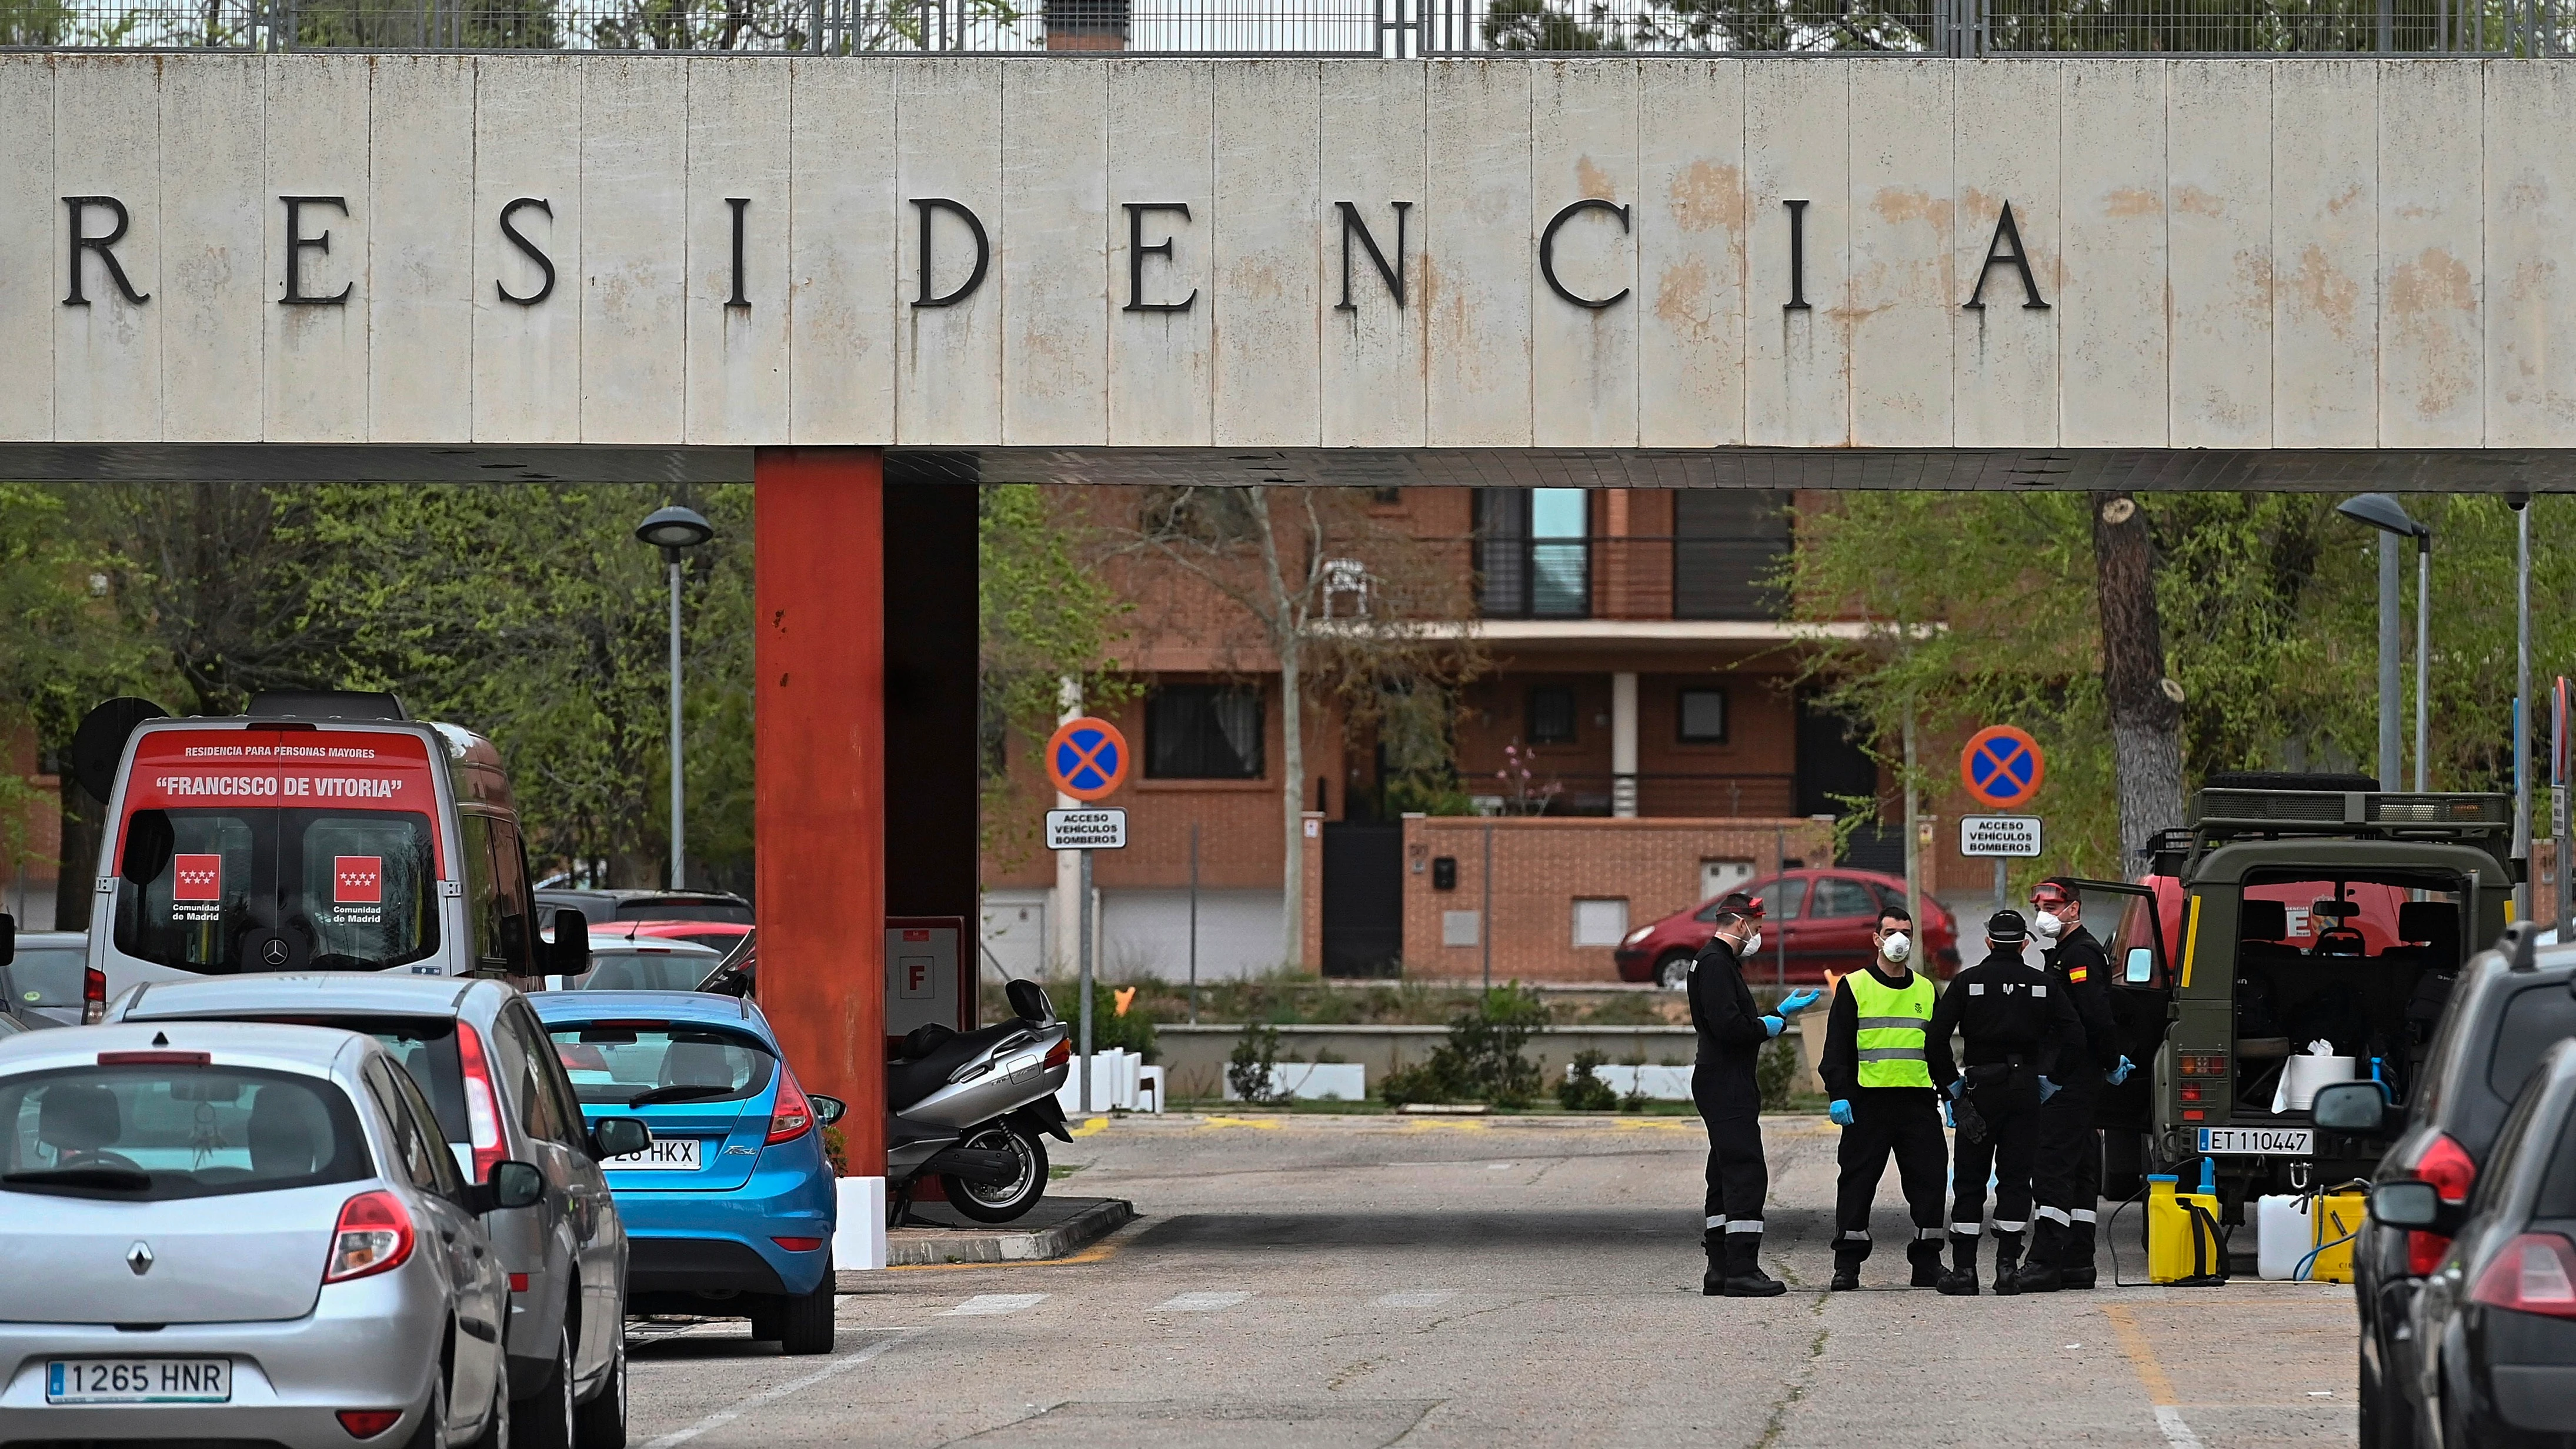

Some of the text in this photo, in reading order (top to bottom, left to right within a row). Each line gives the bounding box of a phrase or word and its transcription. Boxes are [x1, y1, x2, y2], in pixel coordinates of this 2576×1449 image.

[61, 195, 2051, 311] RESIDENCIA
[185, 746, 375, 758] RESIDENCIA PARA PERSONAS MAYORES
[156, 777, 402, 797] “FRANCISCO DE VITORIA”
[1055, 824, 1117, 833] VEHÍCULOS
[1979, 822, 2023, 830] ACCESO
[1056, 836, 1116, 844] BOMBEROS
[1970, 832, 2032, 841] VEHÍCULOS
[1970, 843, 2031, 852] BOMBEROS
[333, 906, 381, 914] Comunidad
[186, 913, 219, 921] Madrid
[333, 914, 381, 923] de Madrid
[909, 966, 925, 990] F
[2212, 1131, 2307, 1151] ET 110447
[651, 1143, 693, 1162] HKX
[74, 1364, 221, 1392] 1265 HNR
